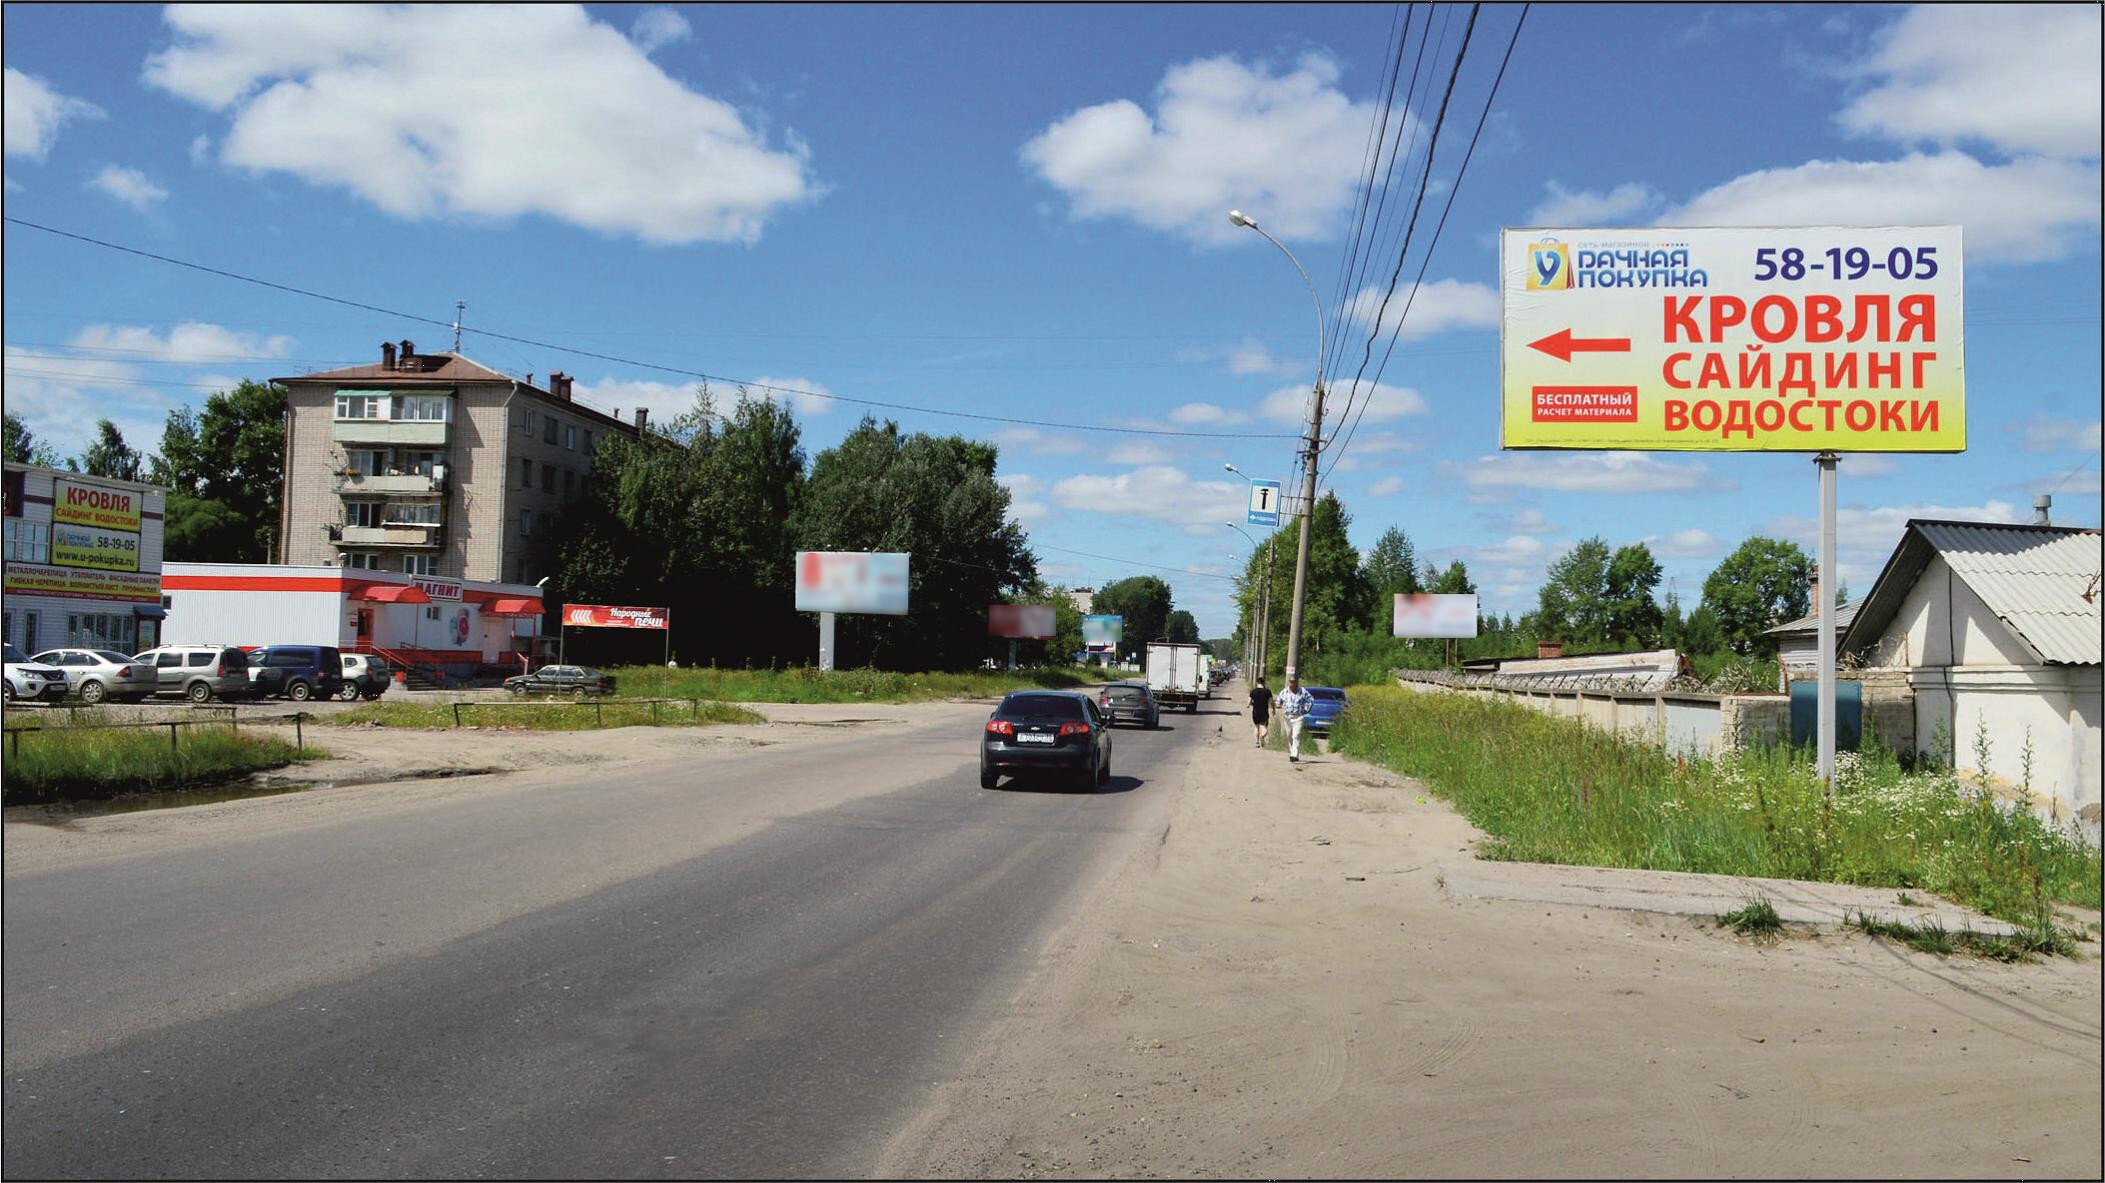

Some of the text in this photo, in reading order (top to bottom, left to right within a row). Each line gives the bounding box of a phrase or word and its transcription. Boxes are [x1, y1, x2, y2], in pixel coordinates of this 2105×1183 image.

[1577, 249, 1689, 269] ДАЧНАЯ
[1754, 247, 1939, 281] 58-19-05
[1577, 269, 1708, 288] ПОКУПКА
[1663, 293, 1937, 344] КРОВЛЯ
[1662, 344, 1937, 398] САЙДИНГ
[1536, 391, 1633, 405] БЕСПЛАТНЫЙ
[1537, 408, 1633, 416] РАСЧЕТ МАТЕРИАЛА
[1663, 400, 1940, 440] ВОДОСТОКИ
[67, 486, 131, 513] КРОВЛЯ
[55, 507, 138, 526] САЙДИНГ ВОДОСТОКИ
[97, 536, 136, 551] 58-19-05
[56, 551, 135, 566] www.u-pokupka.ru
